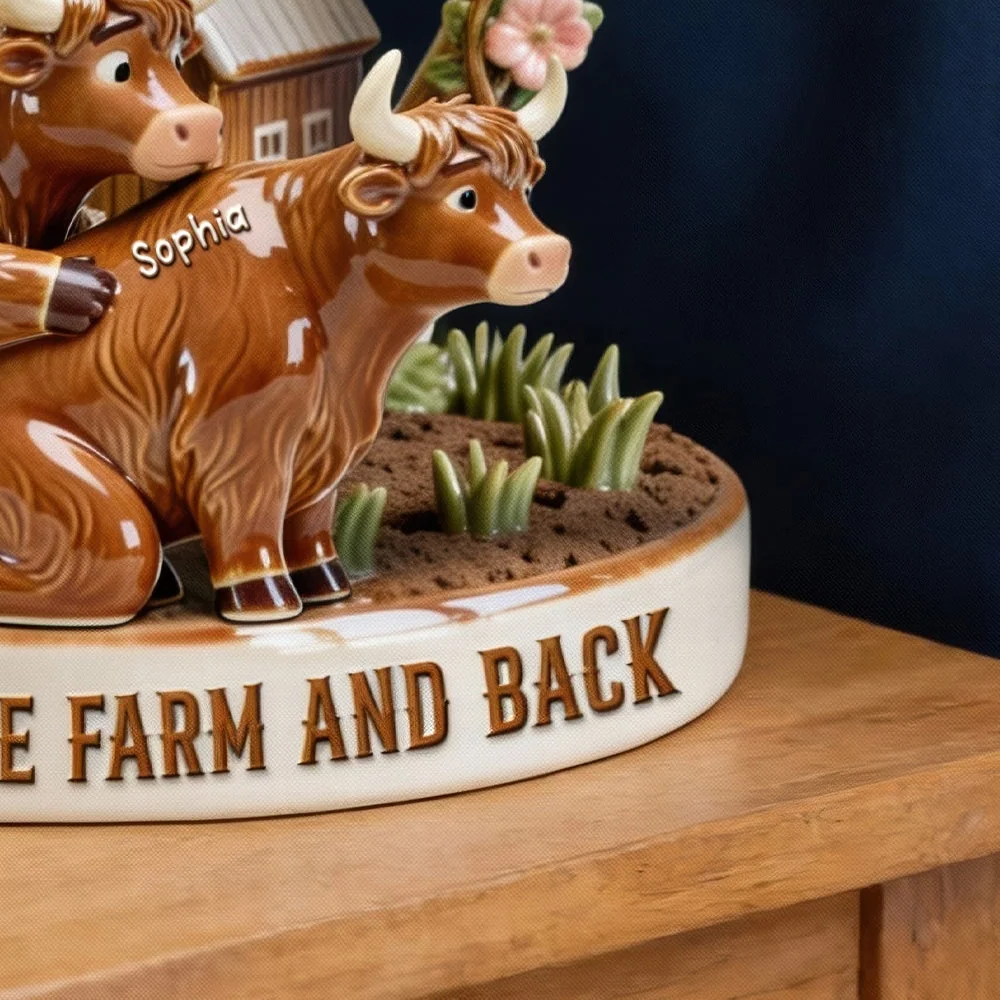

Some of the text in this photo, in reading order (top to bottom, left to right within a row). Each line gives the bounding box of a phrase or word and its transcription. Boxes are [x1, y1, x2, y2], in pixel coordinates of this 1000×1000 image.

[131, 200, 252, 280] Sophia
[66, 681, 267, 784] FARM
[296, 659, 451, 767] AND
[475, 605, 683, 740] BACK
